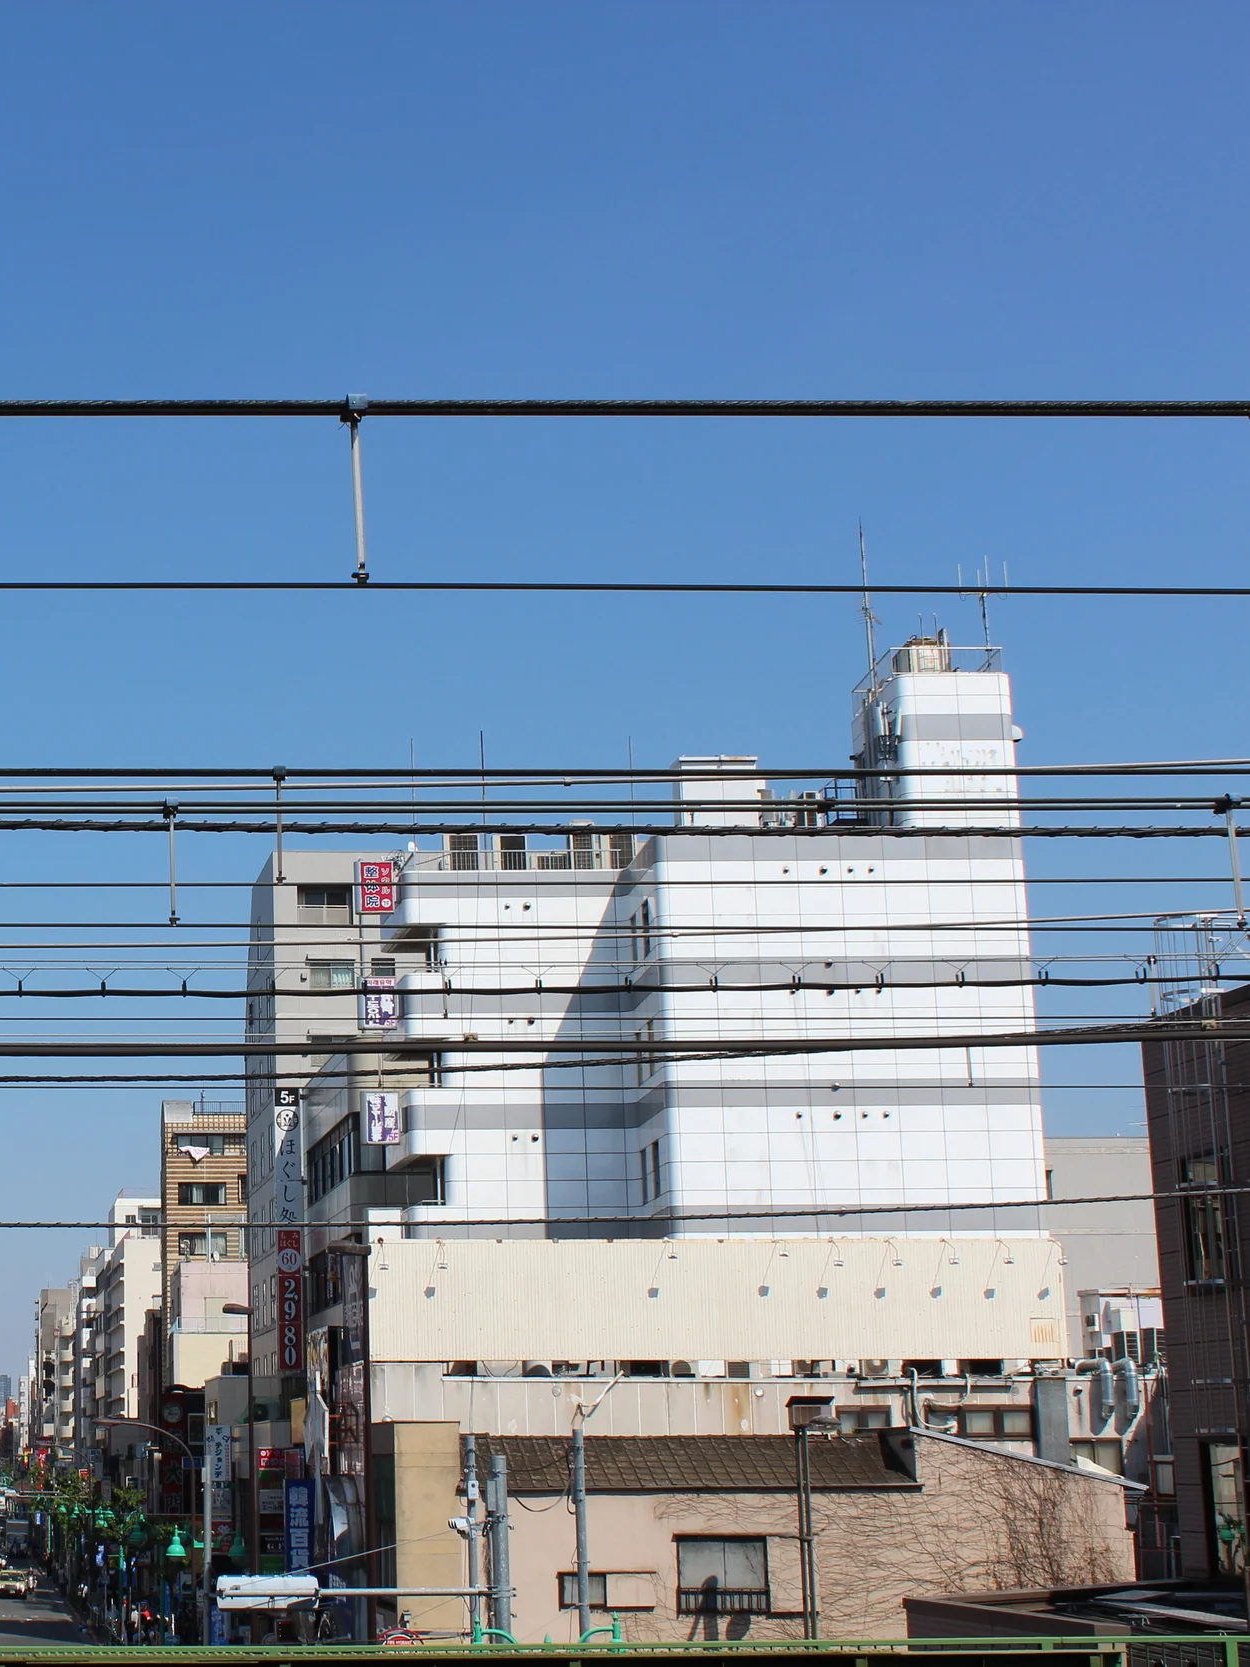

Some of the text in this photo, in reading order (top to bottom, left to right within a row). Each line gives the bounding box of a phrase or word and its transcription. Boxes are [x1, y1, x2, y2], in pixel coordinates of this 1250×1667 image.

[364, 865, 380, 908] 整体院
[280, 1091, 296, 1104] 5F
[280, 1139, 298, 1223] ほぐし処
[281, 1252, 298, 1266] 60
[284, 1278, 299, 1367] 2,980
[289, 1486, 310, 1577] 韓流百貨
